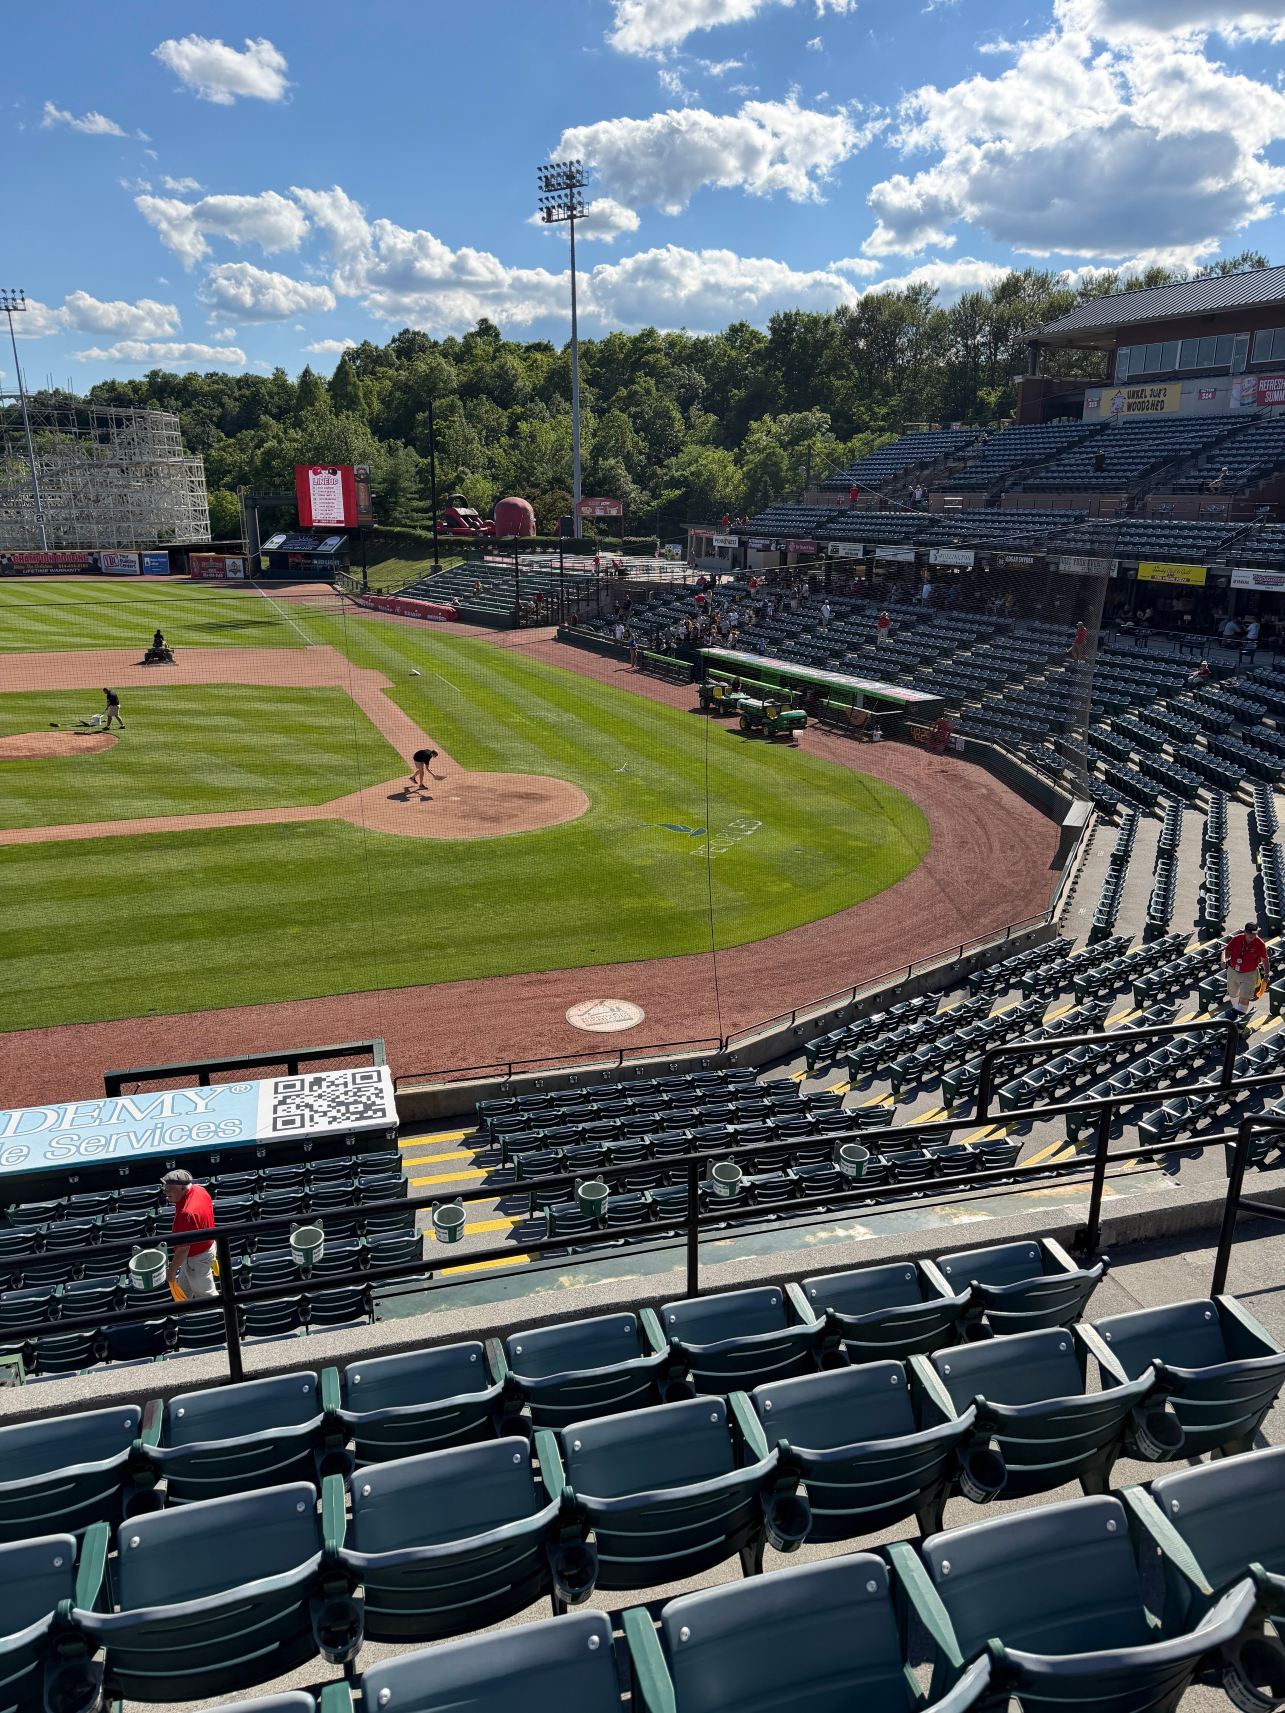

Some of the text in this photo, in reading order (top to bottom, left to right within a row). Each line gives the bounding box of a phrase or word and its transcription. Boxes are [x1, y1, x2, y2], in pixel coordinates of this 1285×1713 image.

[1126, 400, 1165, 412] WOODSHED
[36, 514, 44, 522] 21
[13, 552, 89, 564] CHAMPION ROOFING
[44, 1118, 242, 1160] Services
